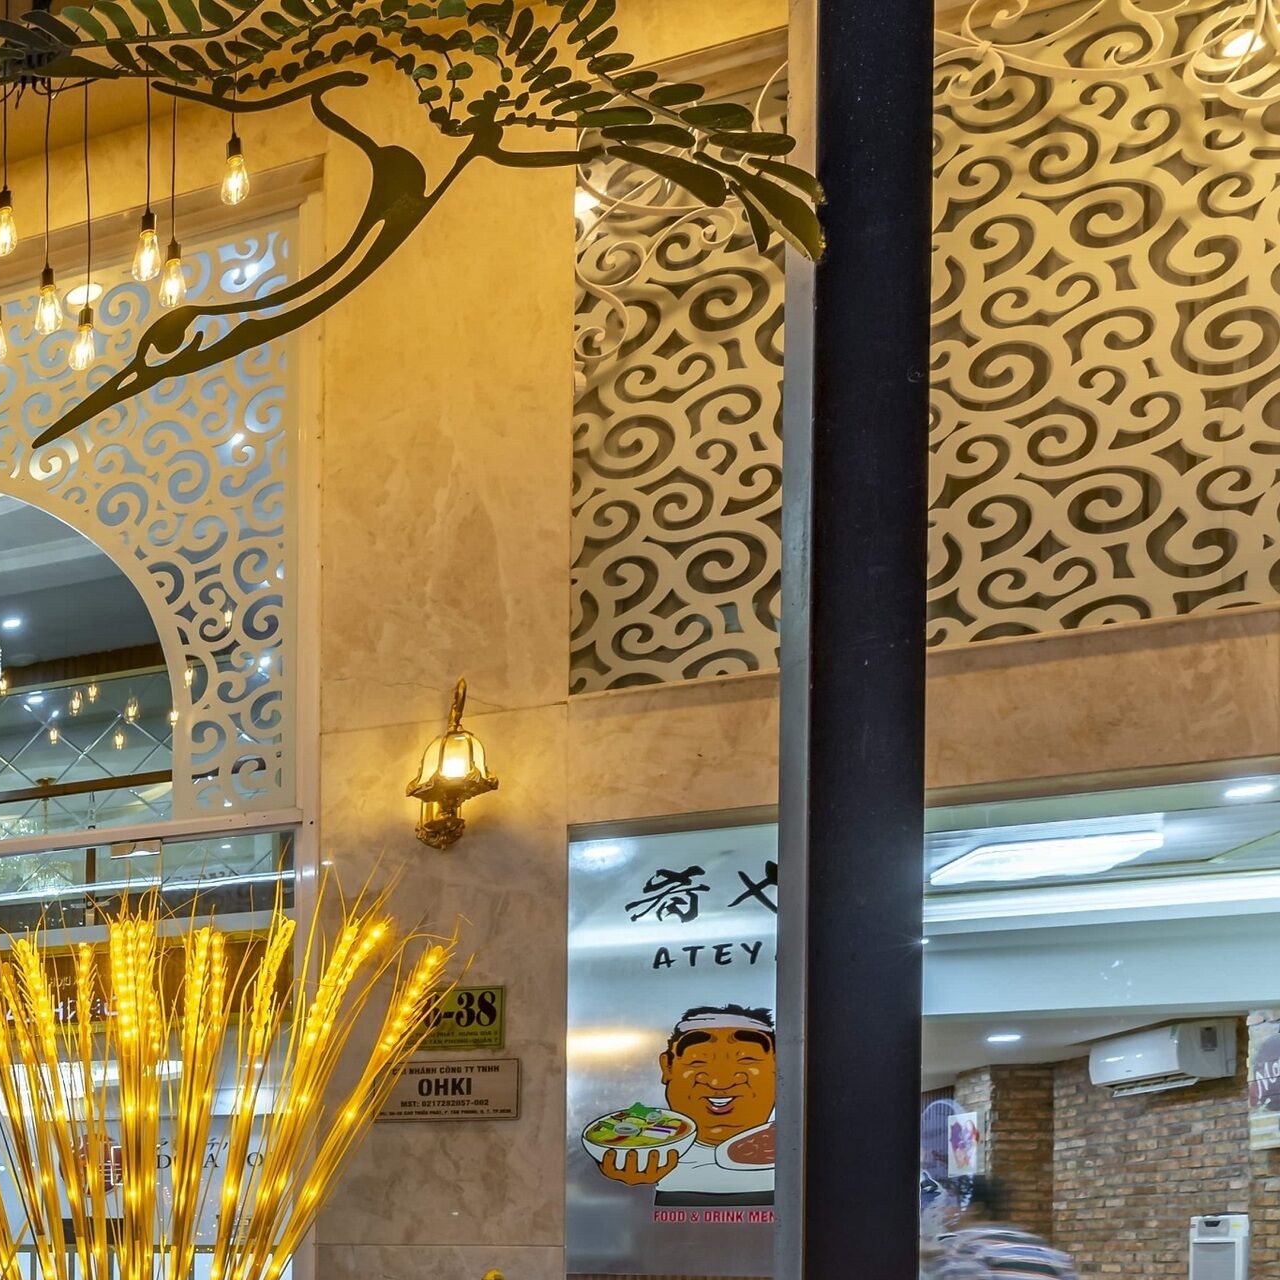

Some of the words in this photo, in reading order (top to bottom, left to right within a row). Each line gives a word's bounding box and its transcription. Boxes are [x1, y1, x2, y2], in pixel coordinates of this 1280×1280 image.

[653, 941, 778, 969] ATEY
[439, 1065, 462, 1074] CÔNG
[464, 1065, 474, 1073] TY
[476, 1065, 500, 1073] TNHH
[417, 1077, 472, 1097] OHKI
[653, 1211, 686, 1223] FOOD
[690, 1210, 700, 1222] &
[704, 1211, 744, 1223] DRINK
[748, 1211, 776, 1223] MEN
